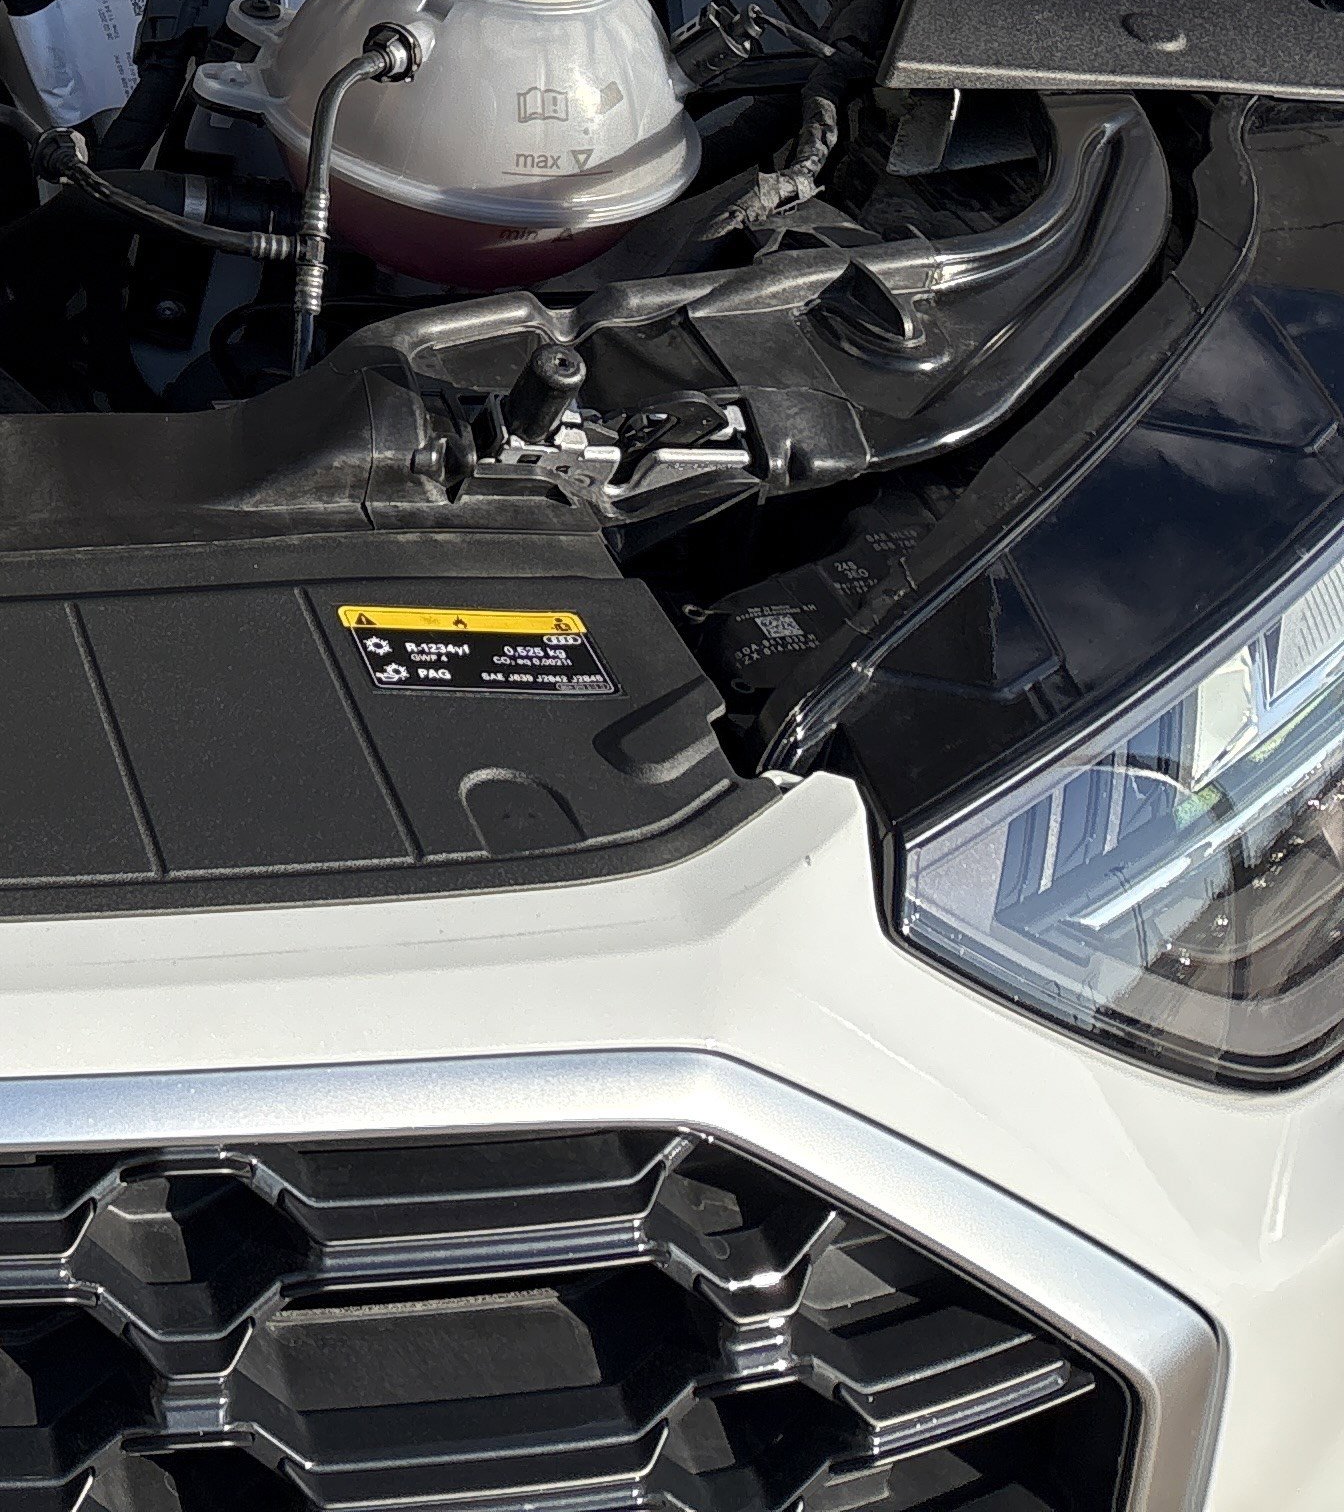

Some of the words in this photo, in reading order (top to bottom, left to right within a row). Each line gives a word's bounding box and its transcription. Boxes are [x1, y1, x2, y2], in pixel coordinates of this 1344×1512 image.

[515, 153, 561, 169] max
[500, 229, 538, 240] min
[405, 642, 470, 655] R-1234yf
[504, 645, 544, 656] 0,525
[546, 647, 566, 659] kg
[411, 653, 437, 662] GWP
[517, 658, 531, 666] eq
[417, 669, 452, 680] PAG
[481, 672, 505, 681] SAE
